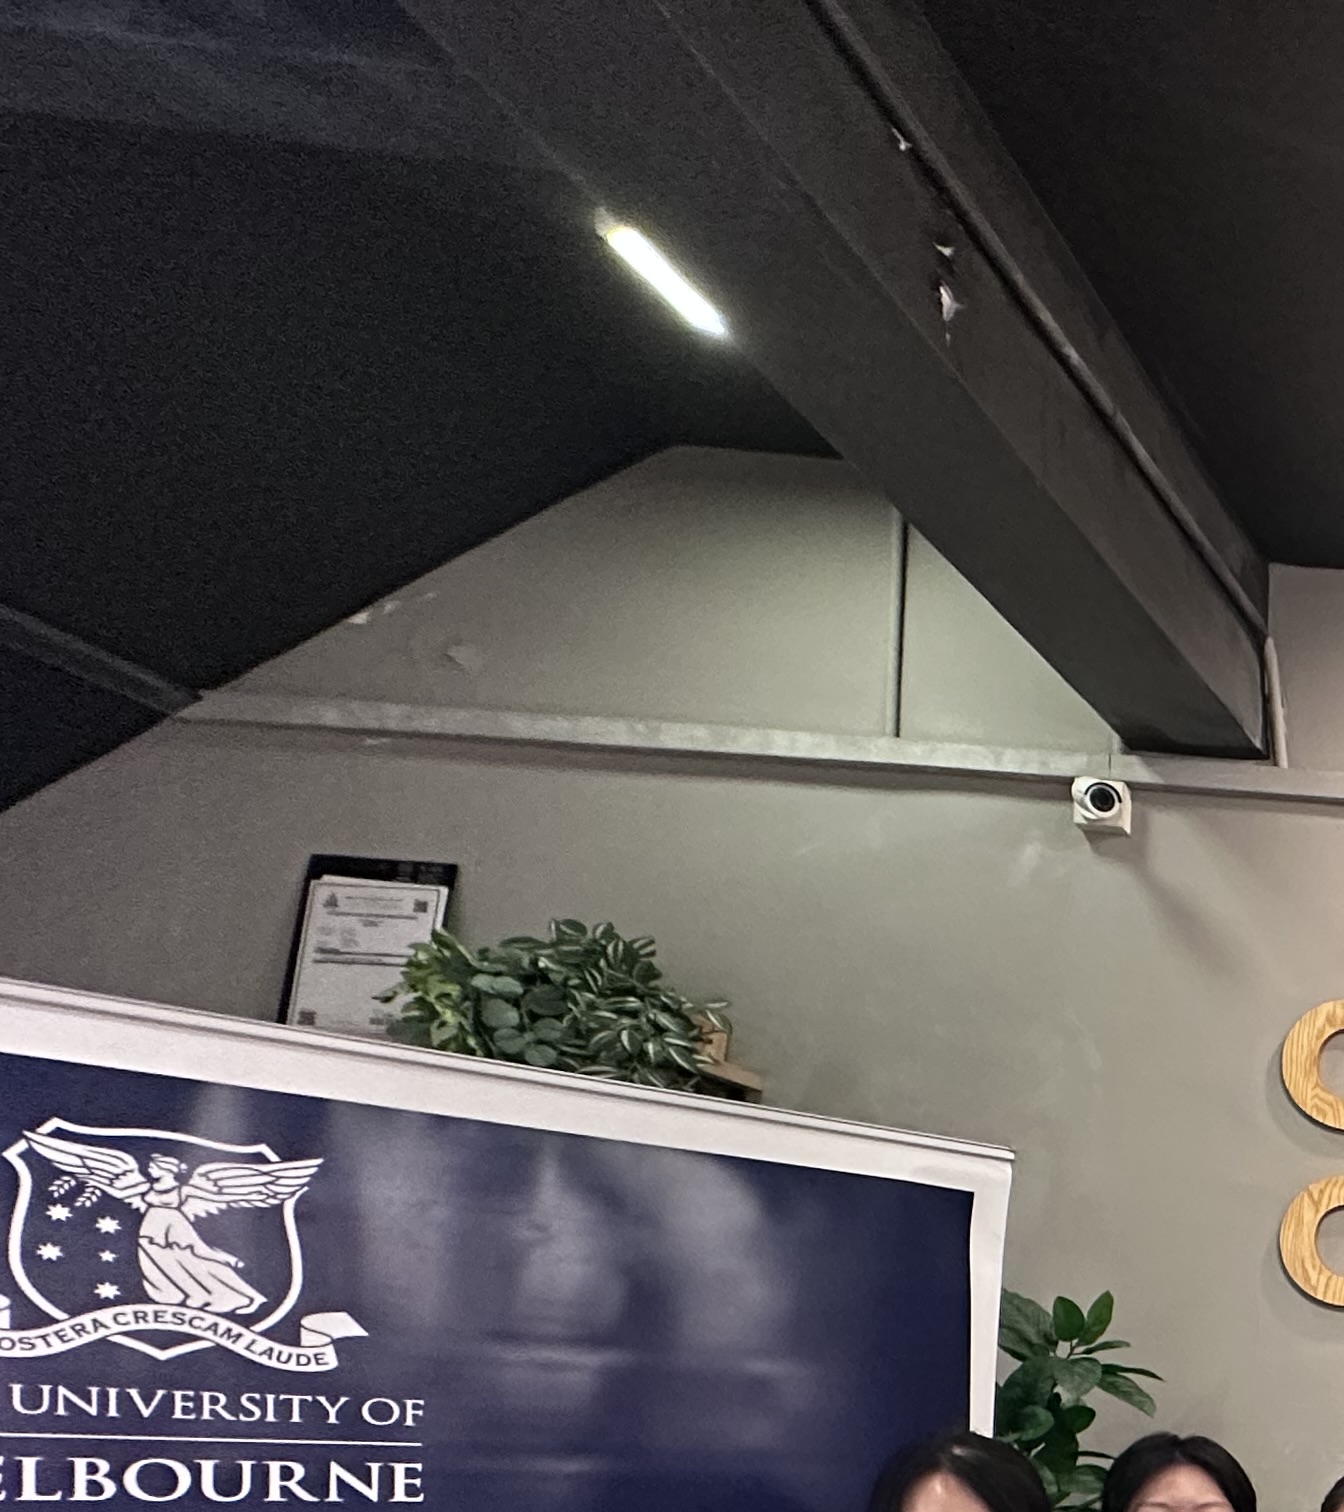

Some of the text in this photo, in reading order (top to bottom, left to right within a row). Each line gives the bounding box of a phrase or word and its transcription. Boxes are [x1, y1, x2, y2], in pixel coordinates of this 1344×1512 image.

[0, 1309, 330, 1367] OSTERA CRESCAM LAUDE
[8, 1382, 426, 1427] UNIVERSITY OF
[0, 1455, 426, 1504] LBOURNE
